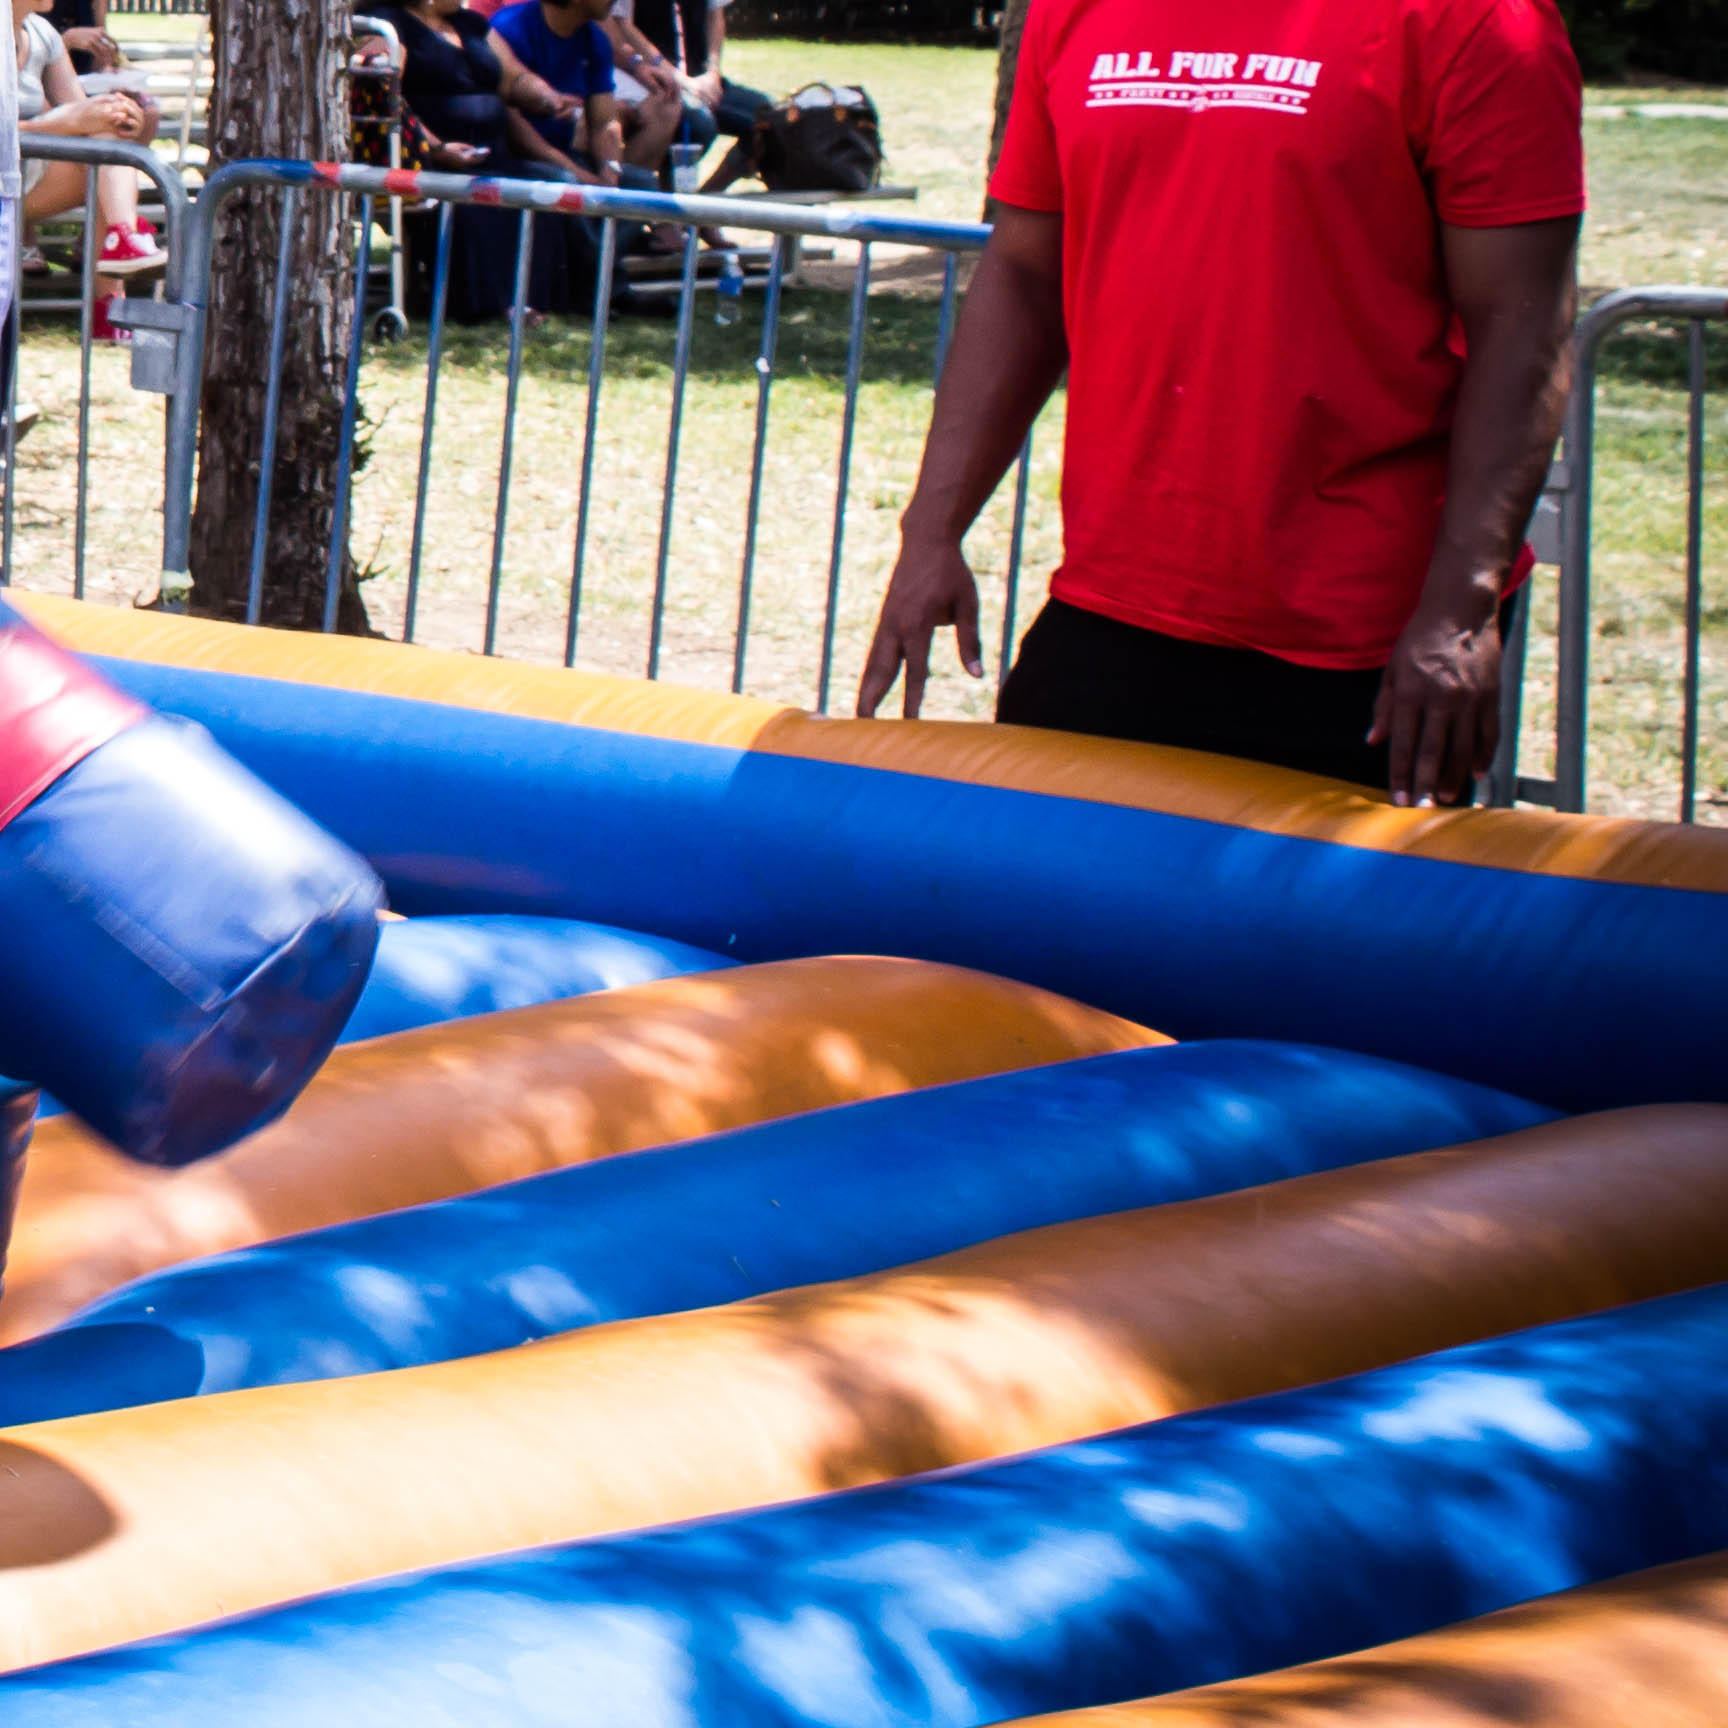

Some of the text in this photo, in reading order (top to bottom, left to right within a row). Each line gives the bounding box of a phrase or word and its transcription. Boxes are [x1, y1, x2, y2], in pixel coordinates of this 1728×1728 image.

[1090, 51, 1322, 87] ALL FOR FUN
